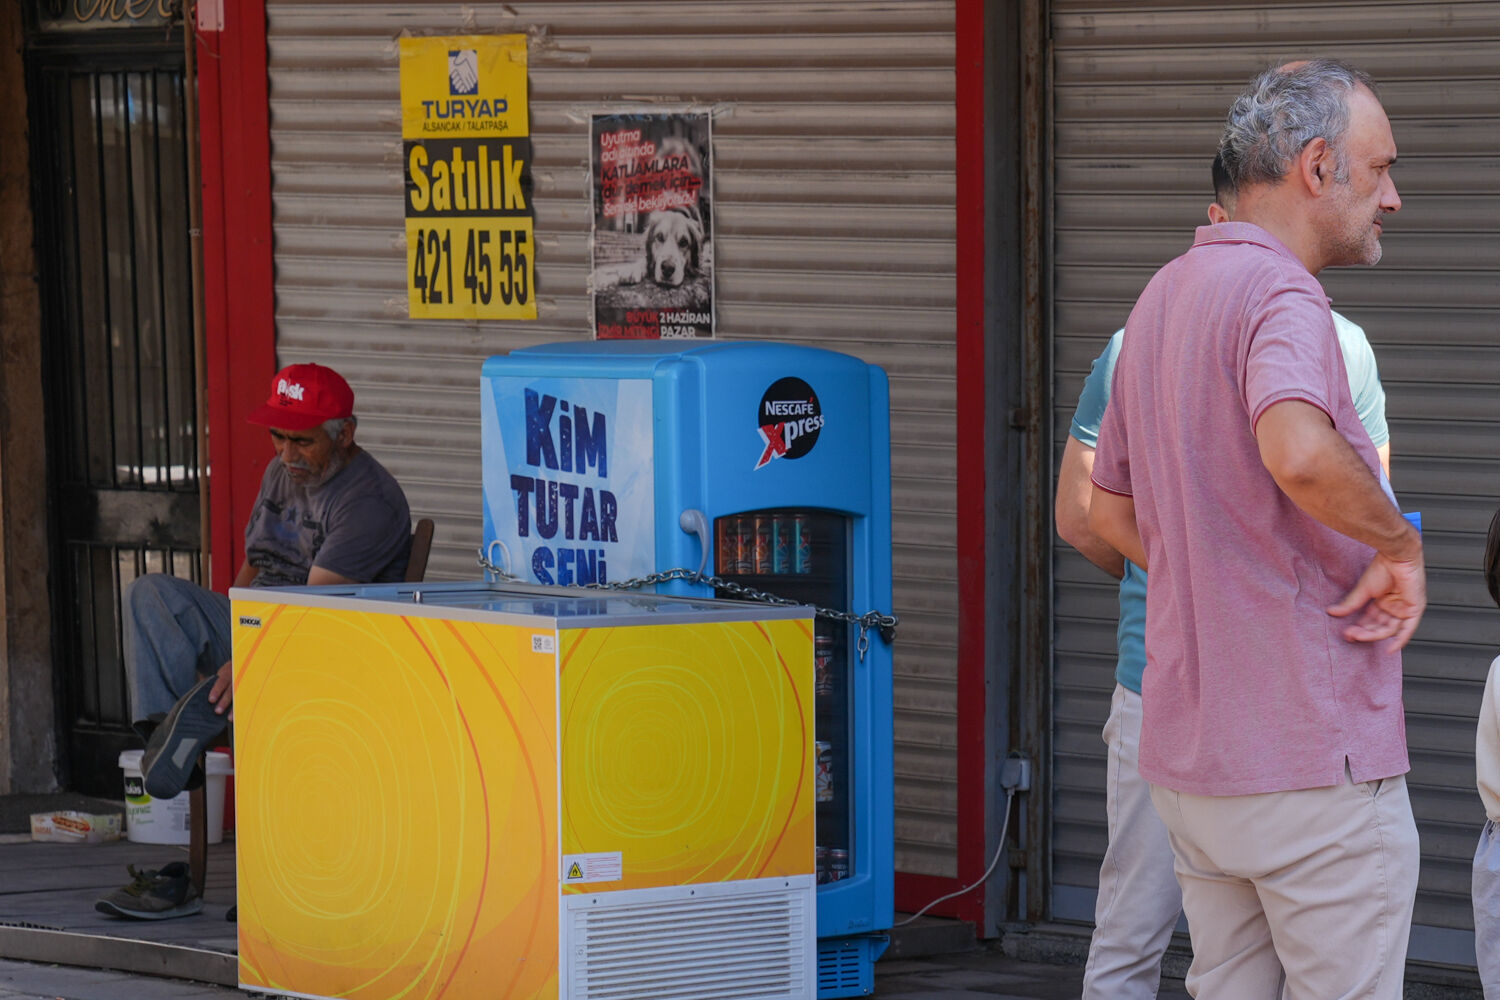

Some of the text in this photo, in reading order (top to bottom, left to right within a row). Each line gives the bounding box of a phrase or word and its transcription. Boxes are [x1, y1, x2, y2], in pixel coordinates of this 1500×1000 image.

[421, 98, 508, 119] TURYAP
[422, 121, 461, 132] ALSANCAK
[408, 144, 527, 212] Satılık
[413, 228, 528, 305] 421 45 55
[667, 309, 711, 324] HAZİRAN
[660, 325, 696, 338] PAZAR
[764, 396, 815, 416] NESCAFÉ
[510, 474, 619, 543] TUTAR
